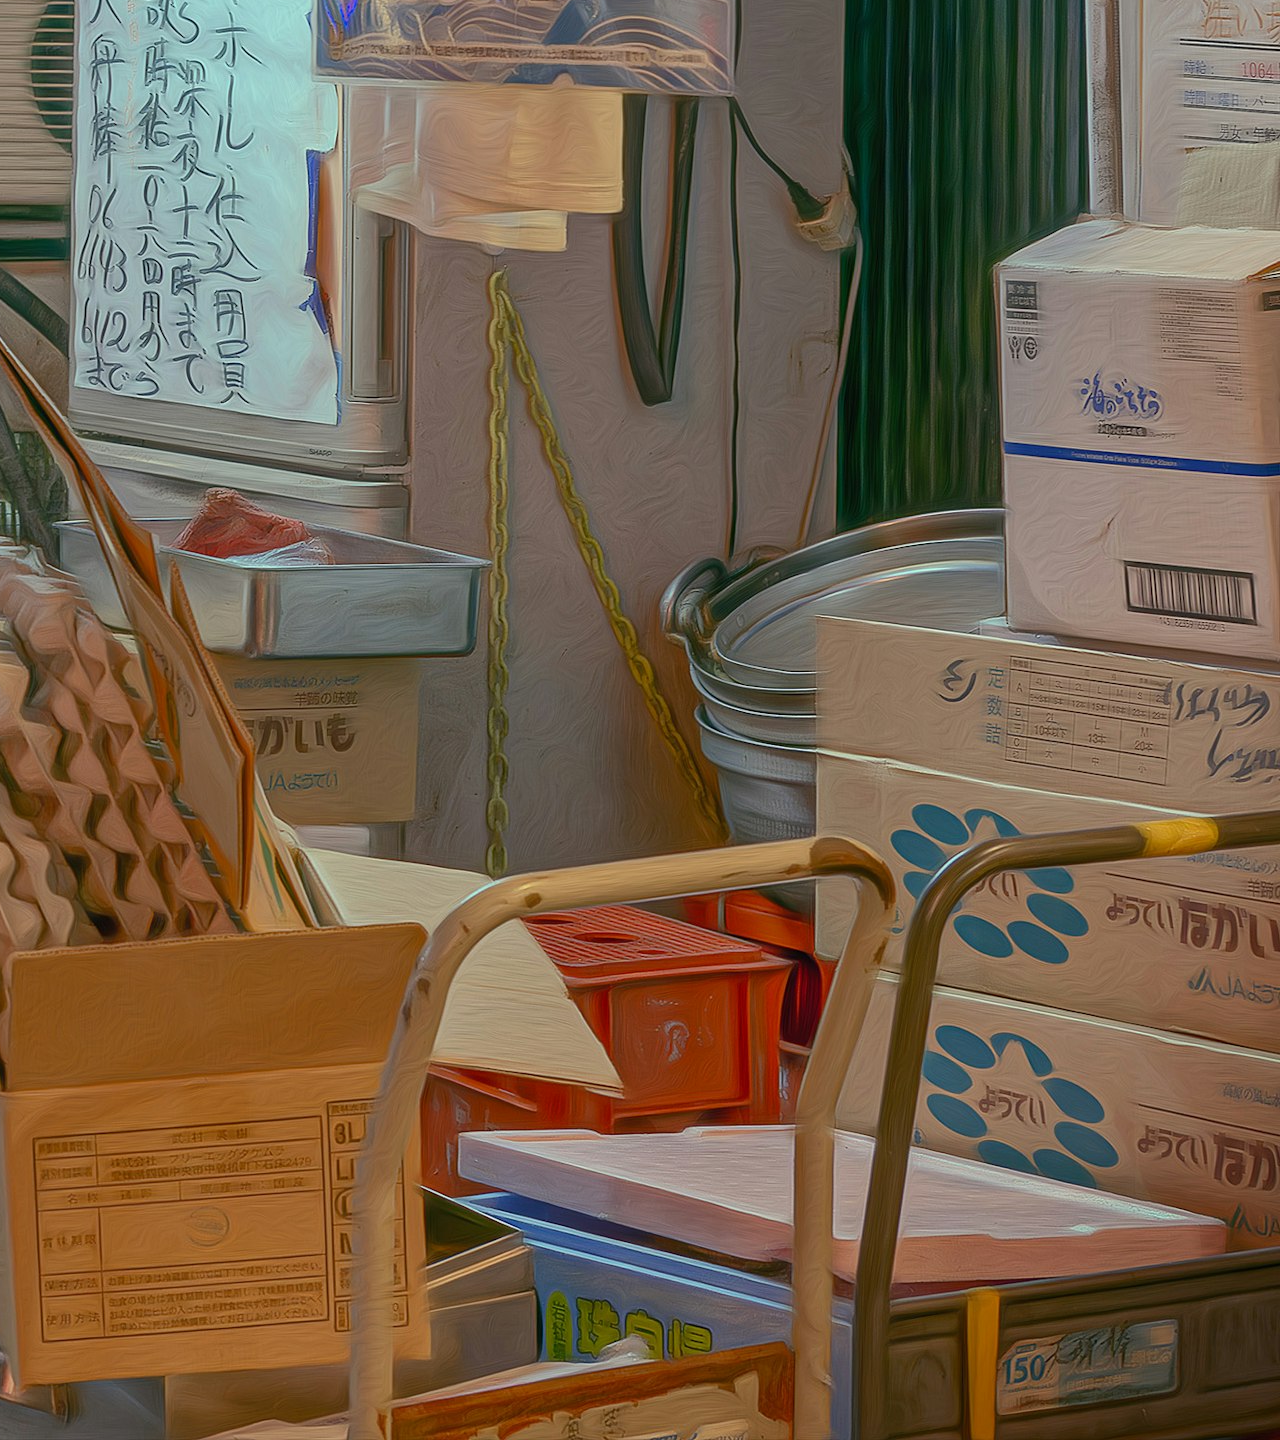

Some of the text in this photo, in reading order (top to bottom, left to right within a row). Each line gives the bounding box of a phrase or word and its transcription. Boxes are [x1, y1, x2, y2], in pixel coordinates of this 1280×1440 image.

[1241, 62, 1280, 78] 1064
[1105, 893, 1175, 931] ようてい
[979, 1085, 1046, 1125] ようてい
[1137, 1125, 1208, 1166] ようてい
[1004, 1354, 1046, 1385] 150
